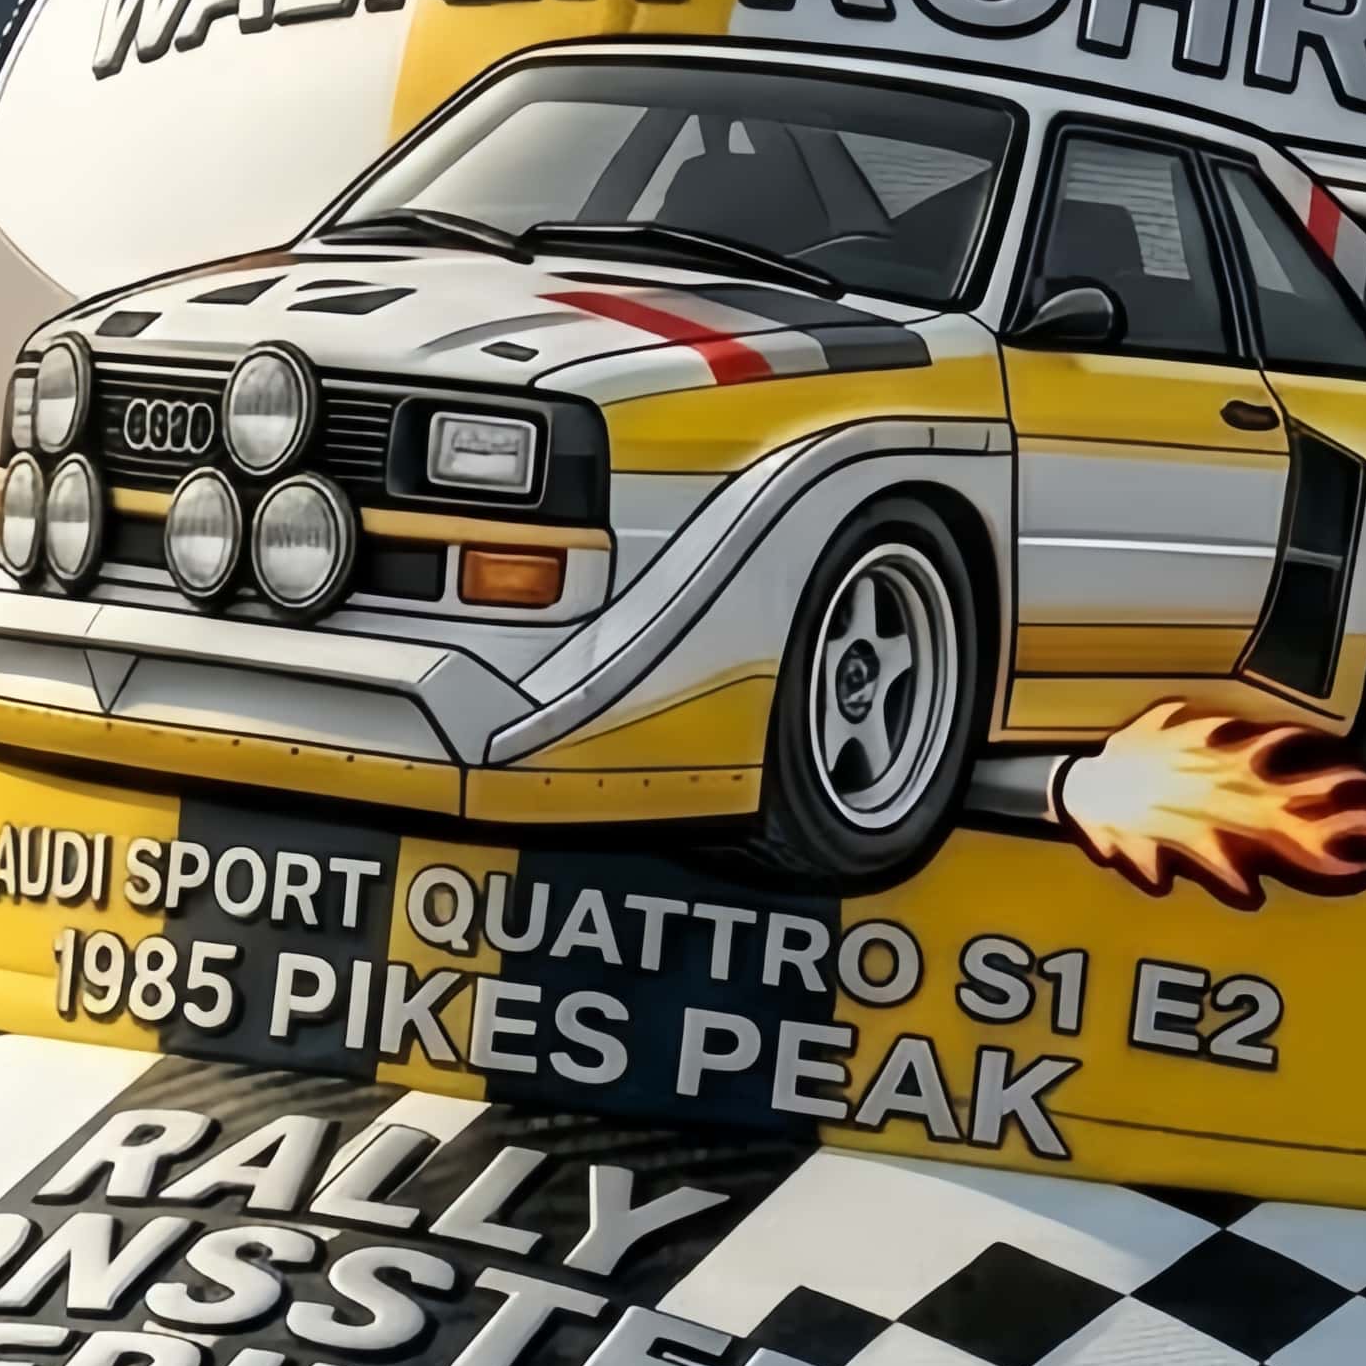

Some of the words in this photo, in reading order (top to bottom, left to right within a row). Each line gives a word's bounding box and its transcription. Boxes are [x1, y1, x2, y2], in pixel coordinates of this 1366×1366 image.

[53, 928, 238, 1032] 1985
[269, 953, 630, 1087] PIKES
[676, 1005, 1080, 1161] PEAK
[124, 840, 381, 928] SPORT
[404, 865, 925, 1007] QUATTRO
[957, 936, 1090, 1034] S1
[1130, 960, 1286, 1072] E2
[39, 1106, 732, 1279] RALLY
